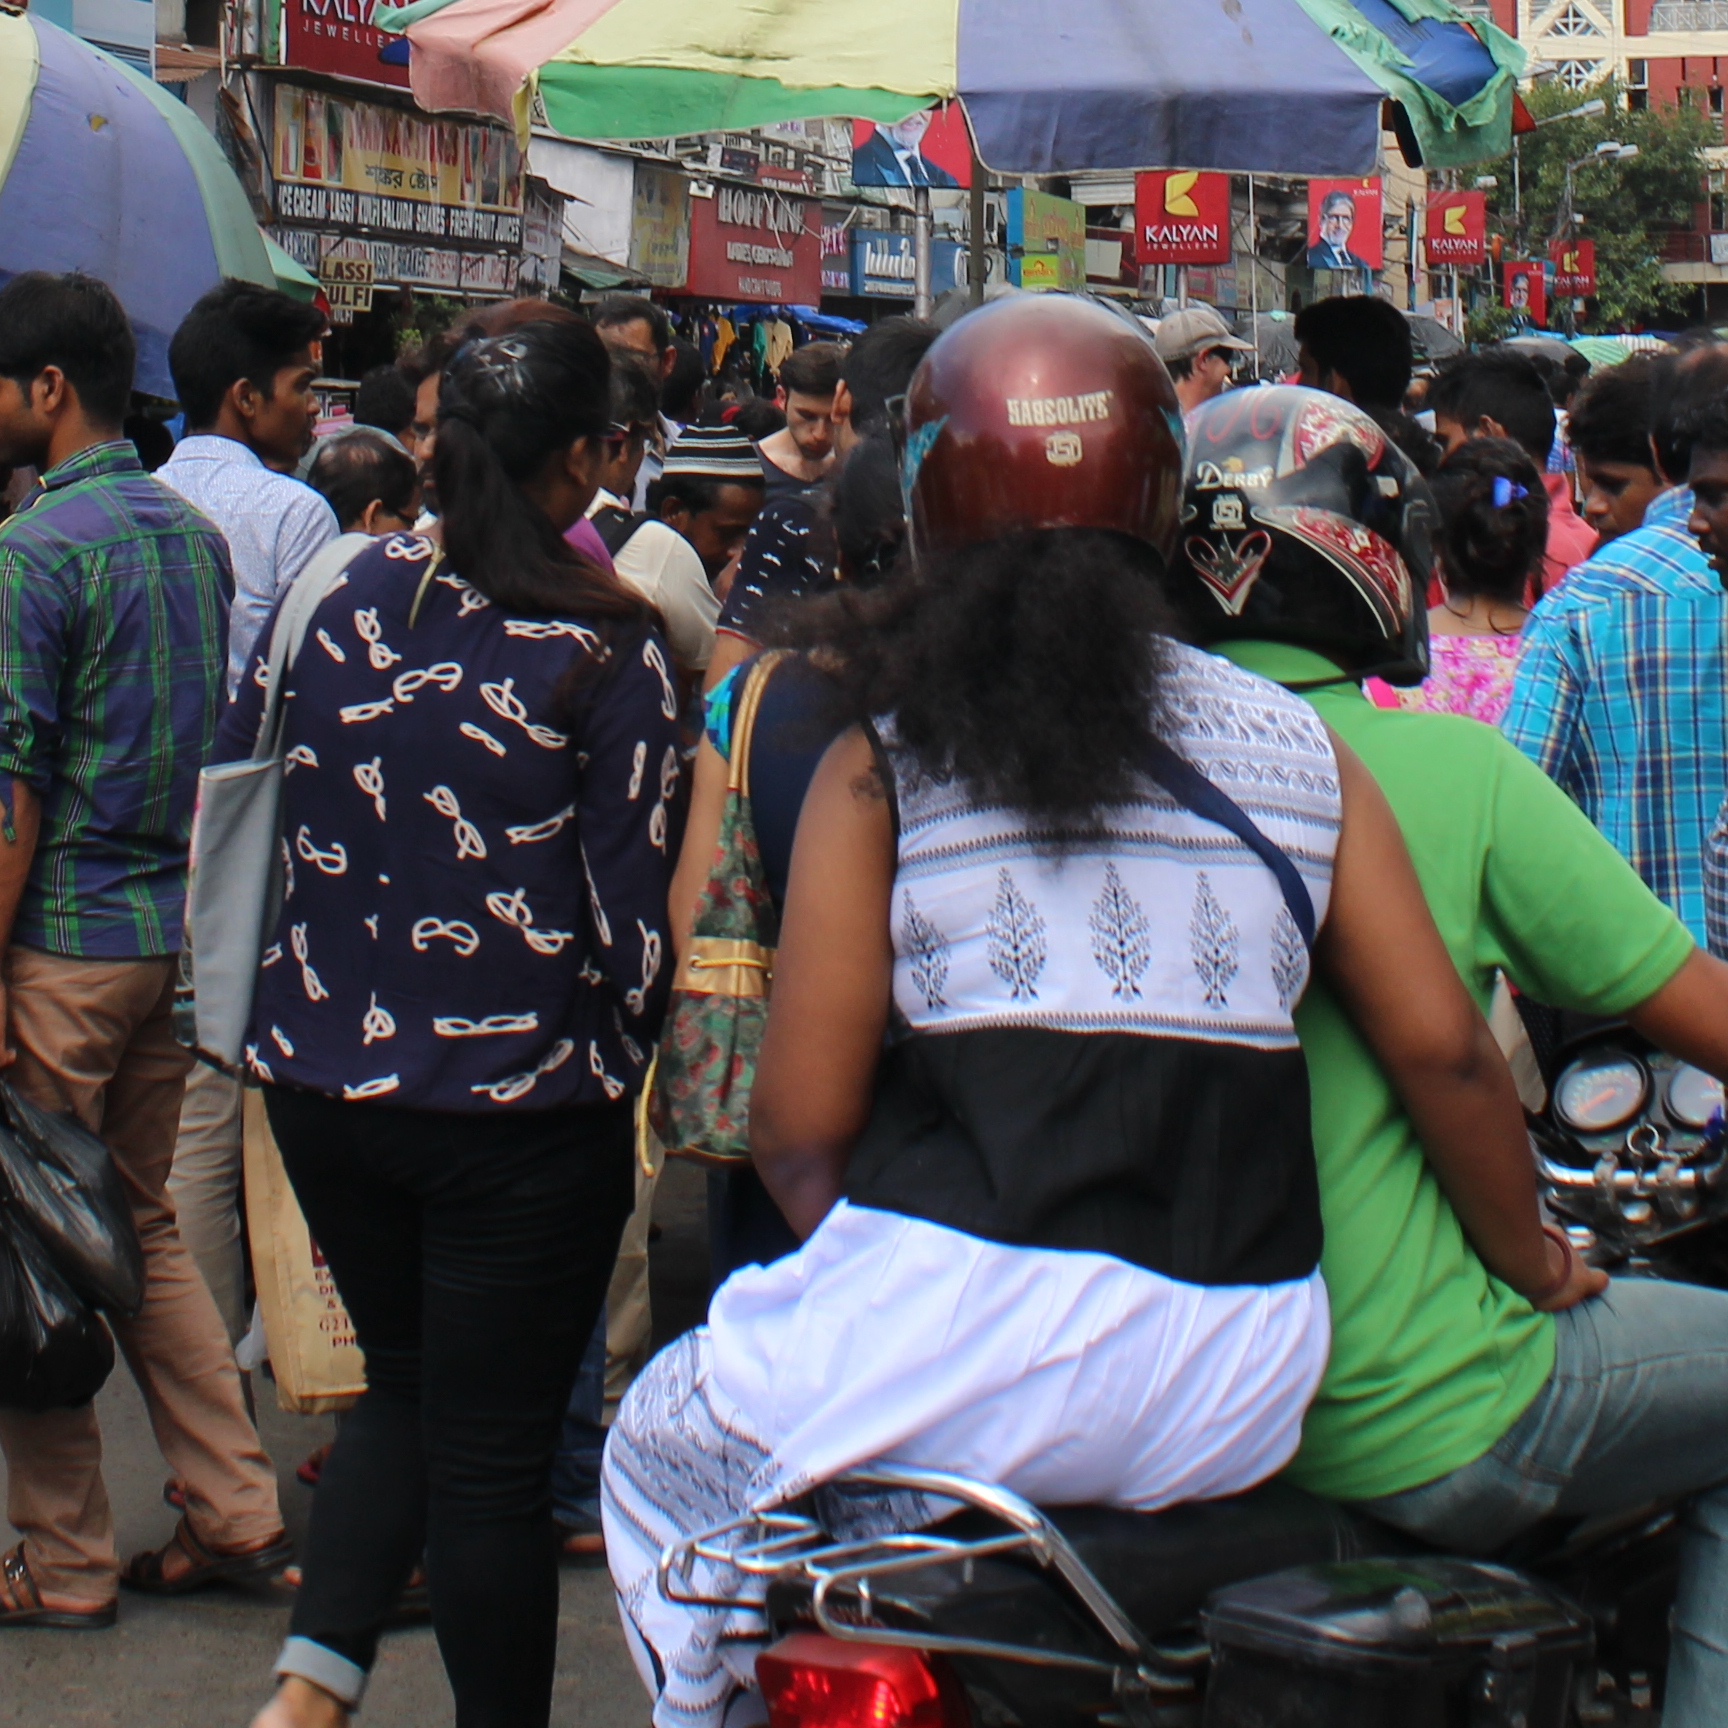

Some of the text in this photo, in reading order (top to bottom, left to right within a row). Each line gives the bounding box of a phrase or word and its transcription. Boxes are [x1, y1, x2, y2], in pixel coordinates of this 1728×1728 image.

[303, 20, 396, 49] JEWELLE
[293, 186, 327, 220] CREAM
[330, 191, 355, 223] LASSI
[382, 198, 414, 229] FALUDA
[473, 211, 495, 242] FRUIT
[1145, 224, 1218, 243] KALYAN
[1431, 238, 1479, 251] KALYAN
[322, 261, 372, 282] LASSI
[326, 285, 371, 308] ULFI
